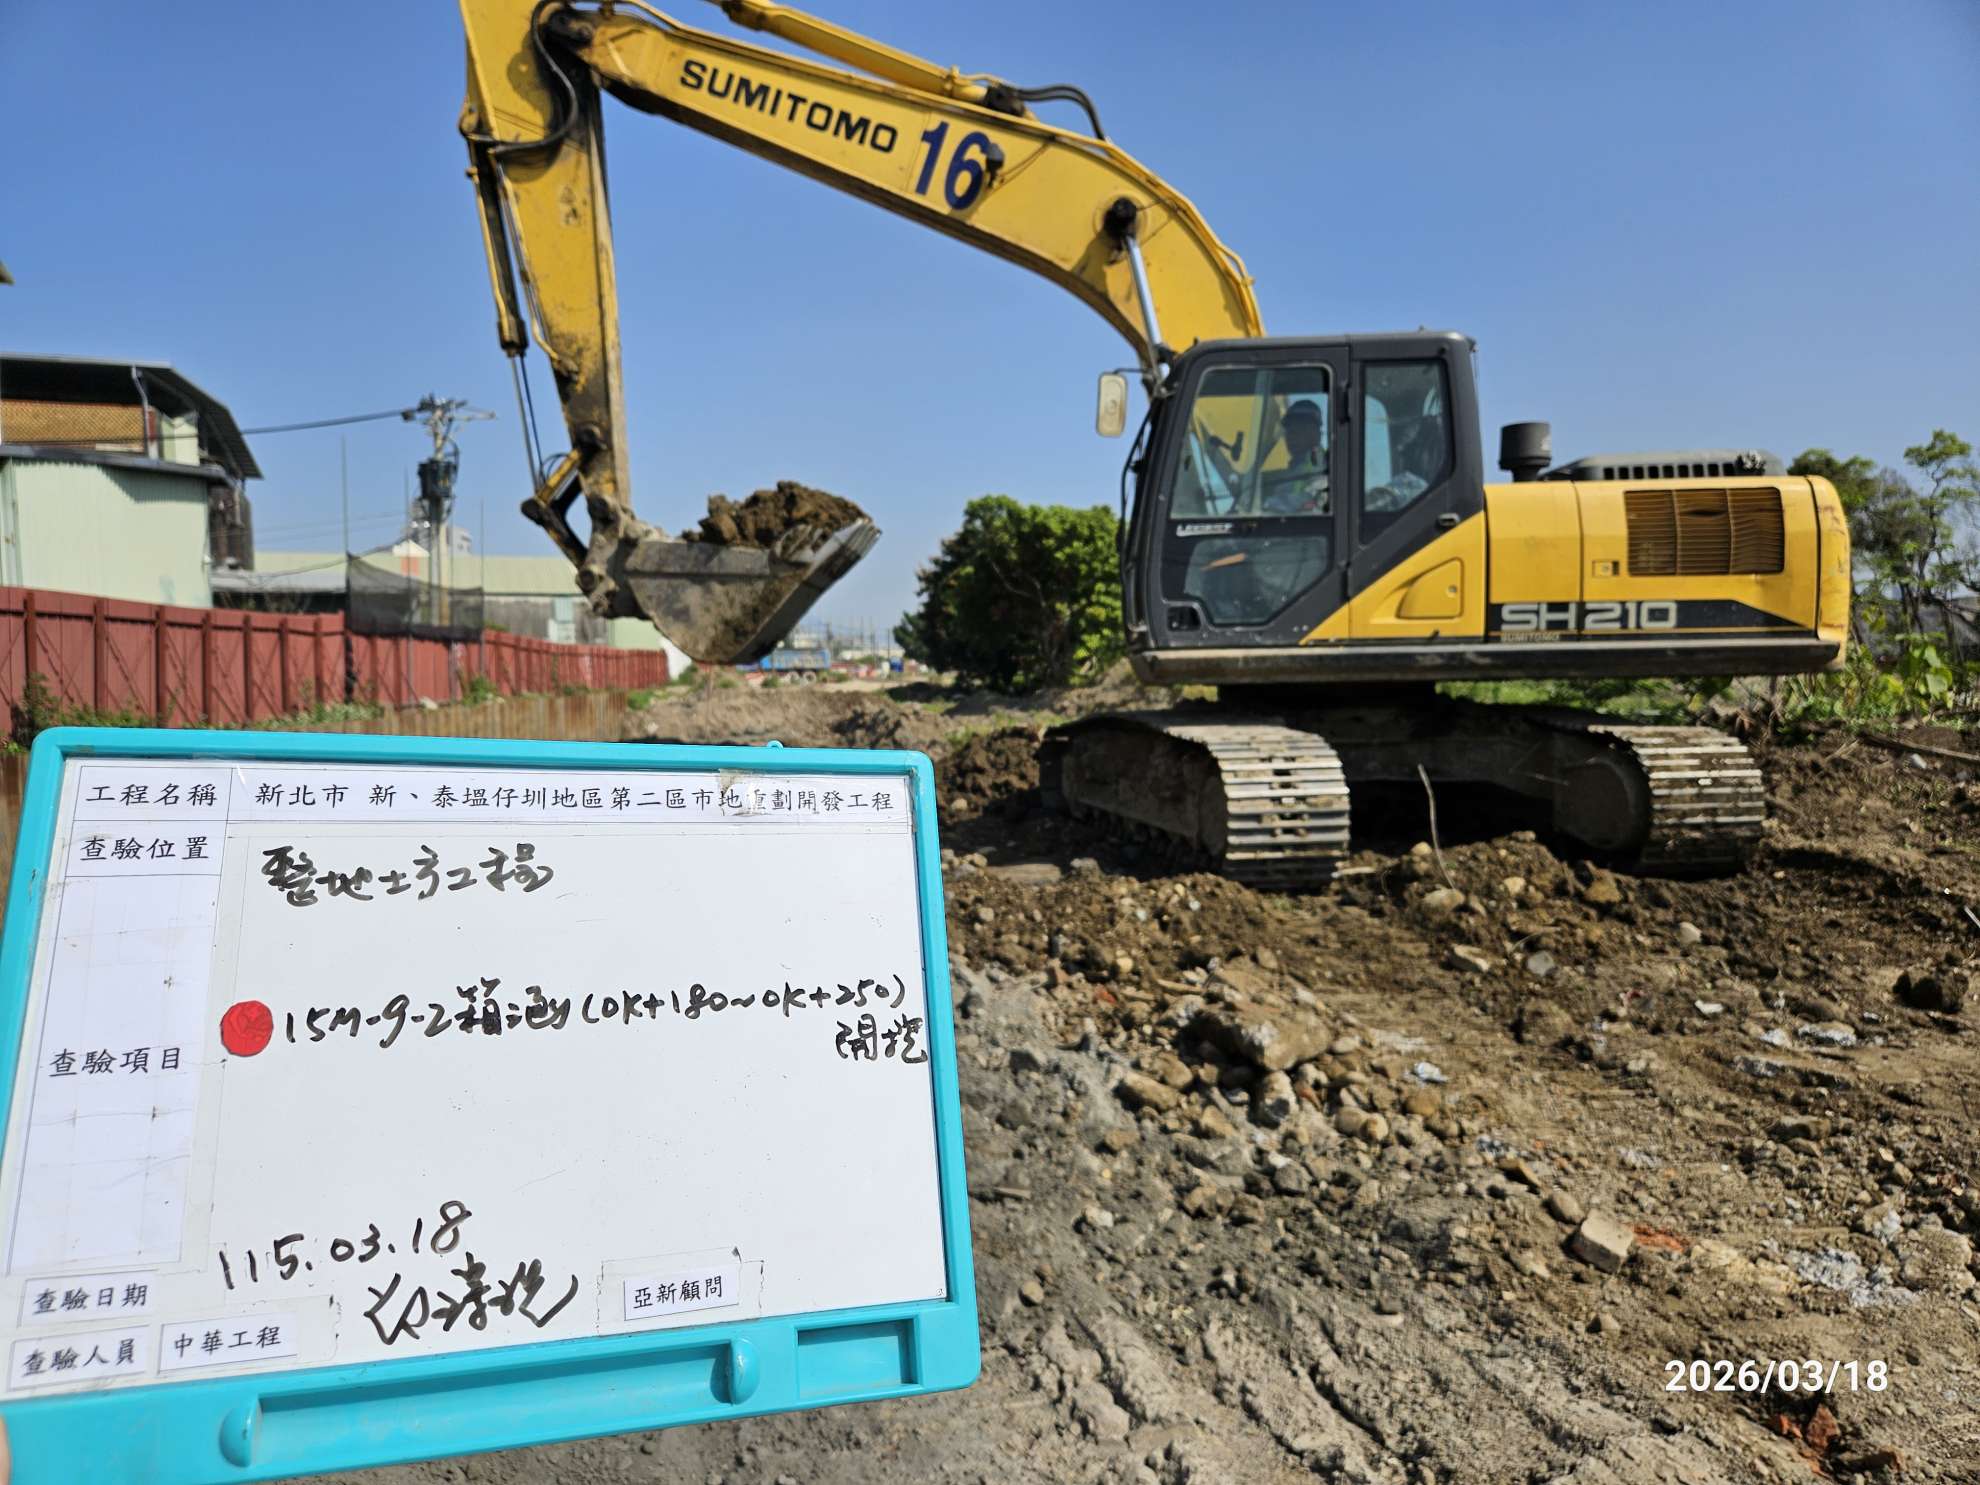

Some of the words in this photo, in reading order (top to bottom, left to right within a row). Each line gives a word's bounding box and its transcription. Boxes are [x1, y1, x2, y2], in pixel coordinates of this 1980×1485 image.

[680, 59, 898, 153] SUMITOMO
[915, 121, 992, 211] 16
[86, 783, 217, 807] 工程名稱
[255, 782, 349, 809] 新北市
[80, 836, 209, 861] 查驗位置
[48, 1048, 181, 1077] 查驗項目
[219, 1200, 472, 1290] 115.03.18
[33, 1284, 148, 1316] 查驗日期
[633, 1275, 722, 1309] 亞新顧問
[22, 1338, 136, 1377] 查驗人員
[174, 1325, 282, 1358] 中華工程
